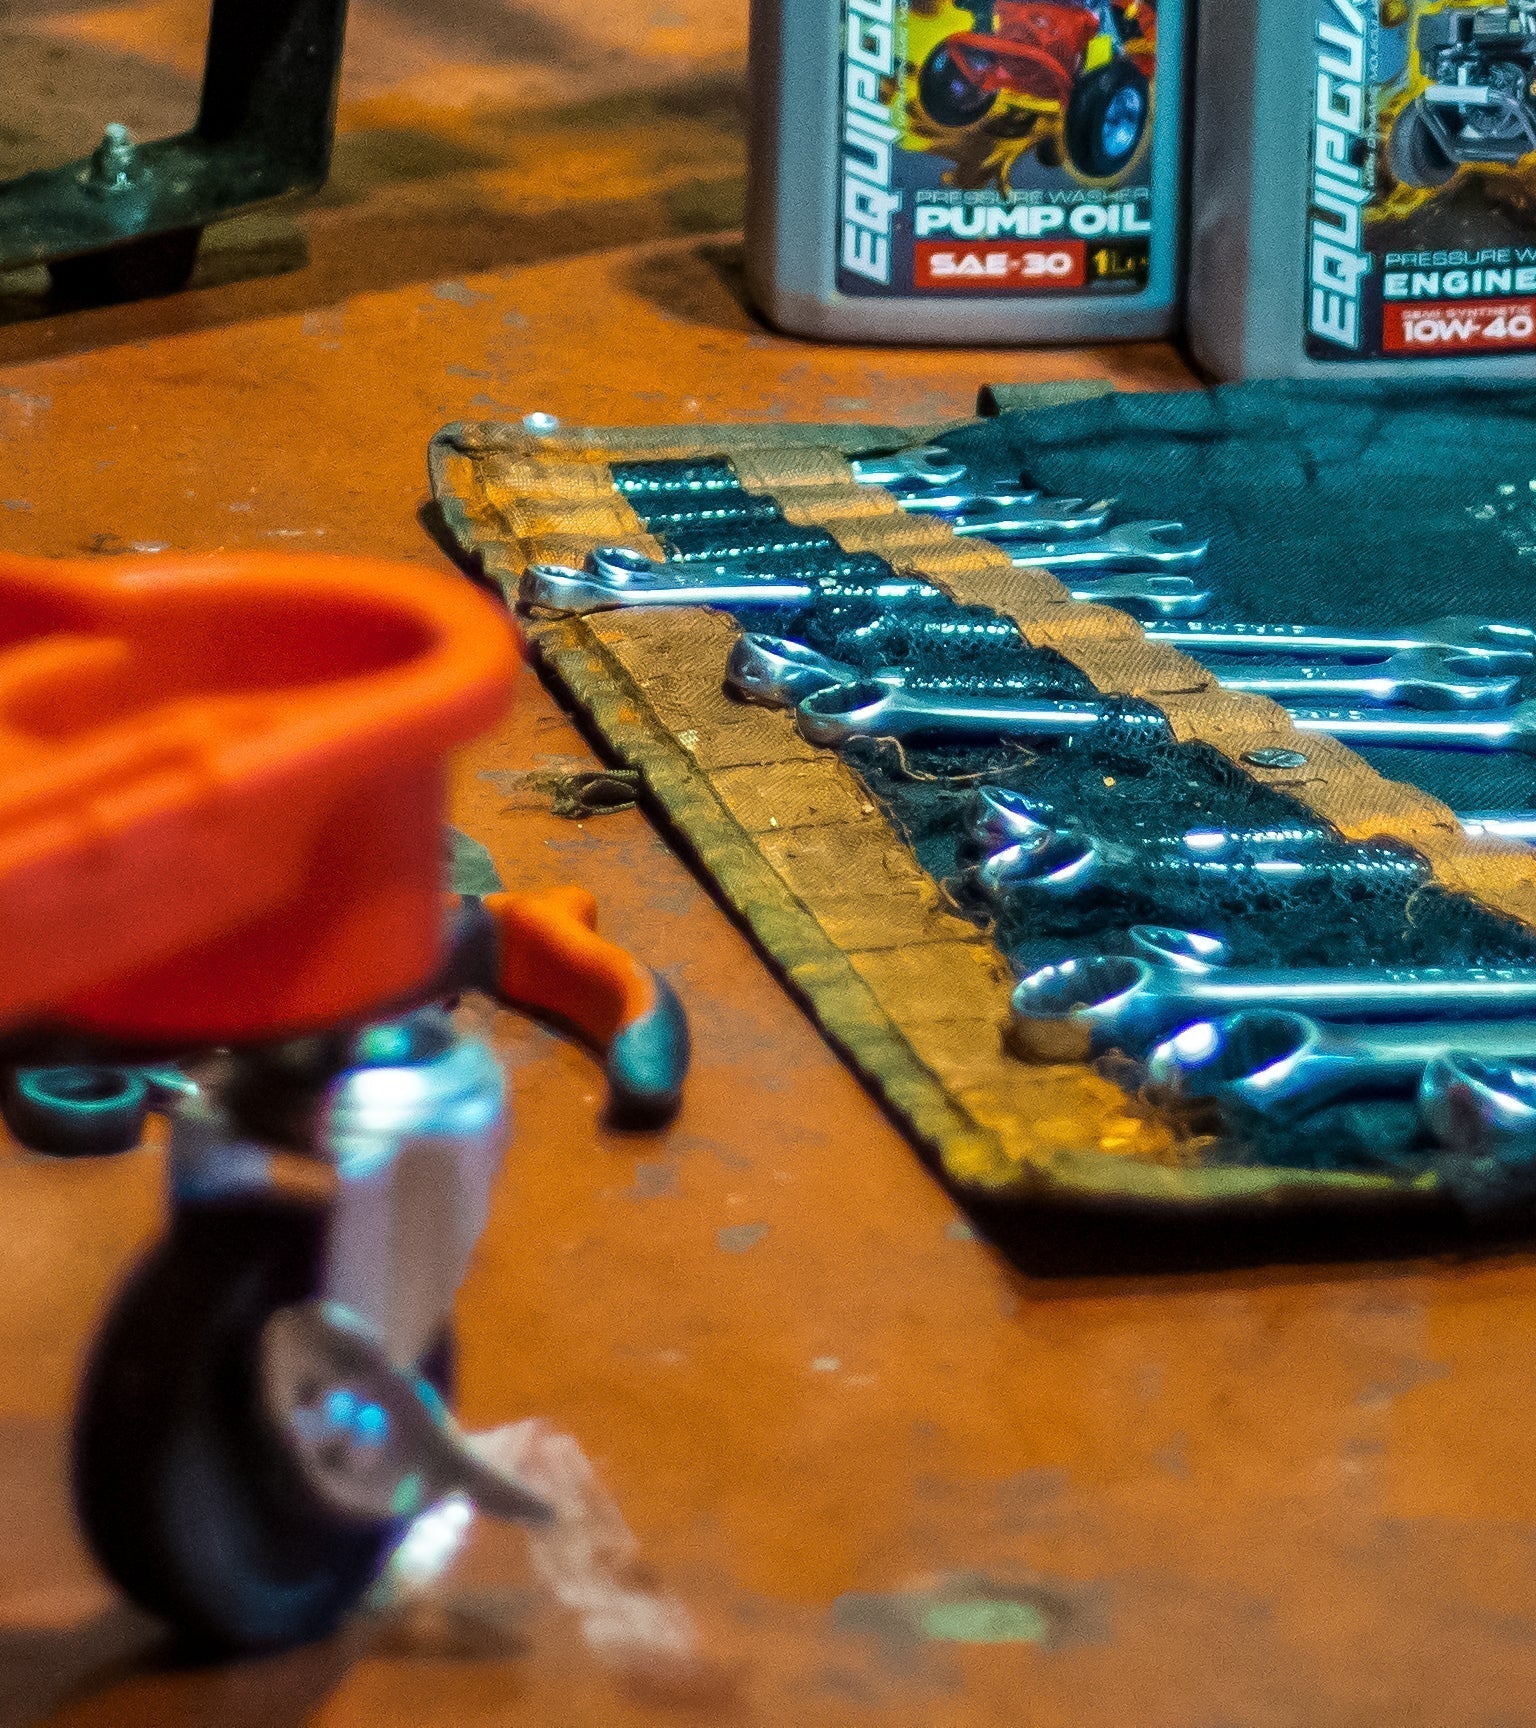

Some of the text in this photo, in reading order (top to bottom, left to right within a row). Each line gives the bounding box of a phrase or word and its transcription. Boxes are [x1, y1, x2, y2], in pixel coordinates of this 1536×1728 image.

[916, 187, 1150, 205] PRESSURE WASHER
[916, 203, 1152, 238] PUMP OIL
[1385, 250, 1511, 267] PRESSURE
[1403, 315, 1534, 342] 10W-40
